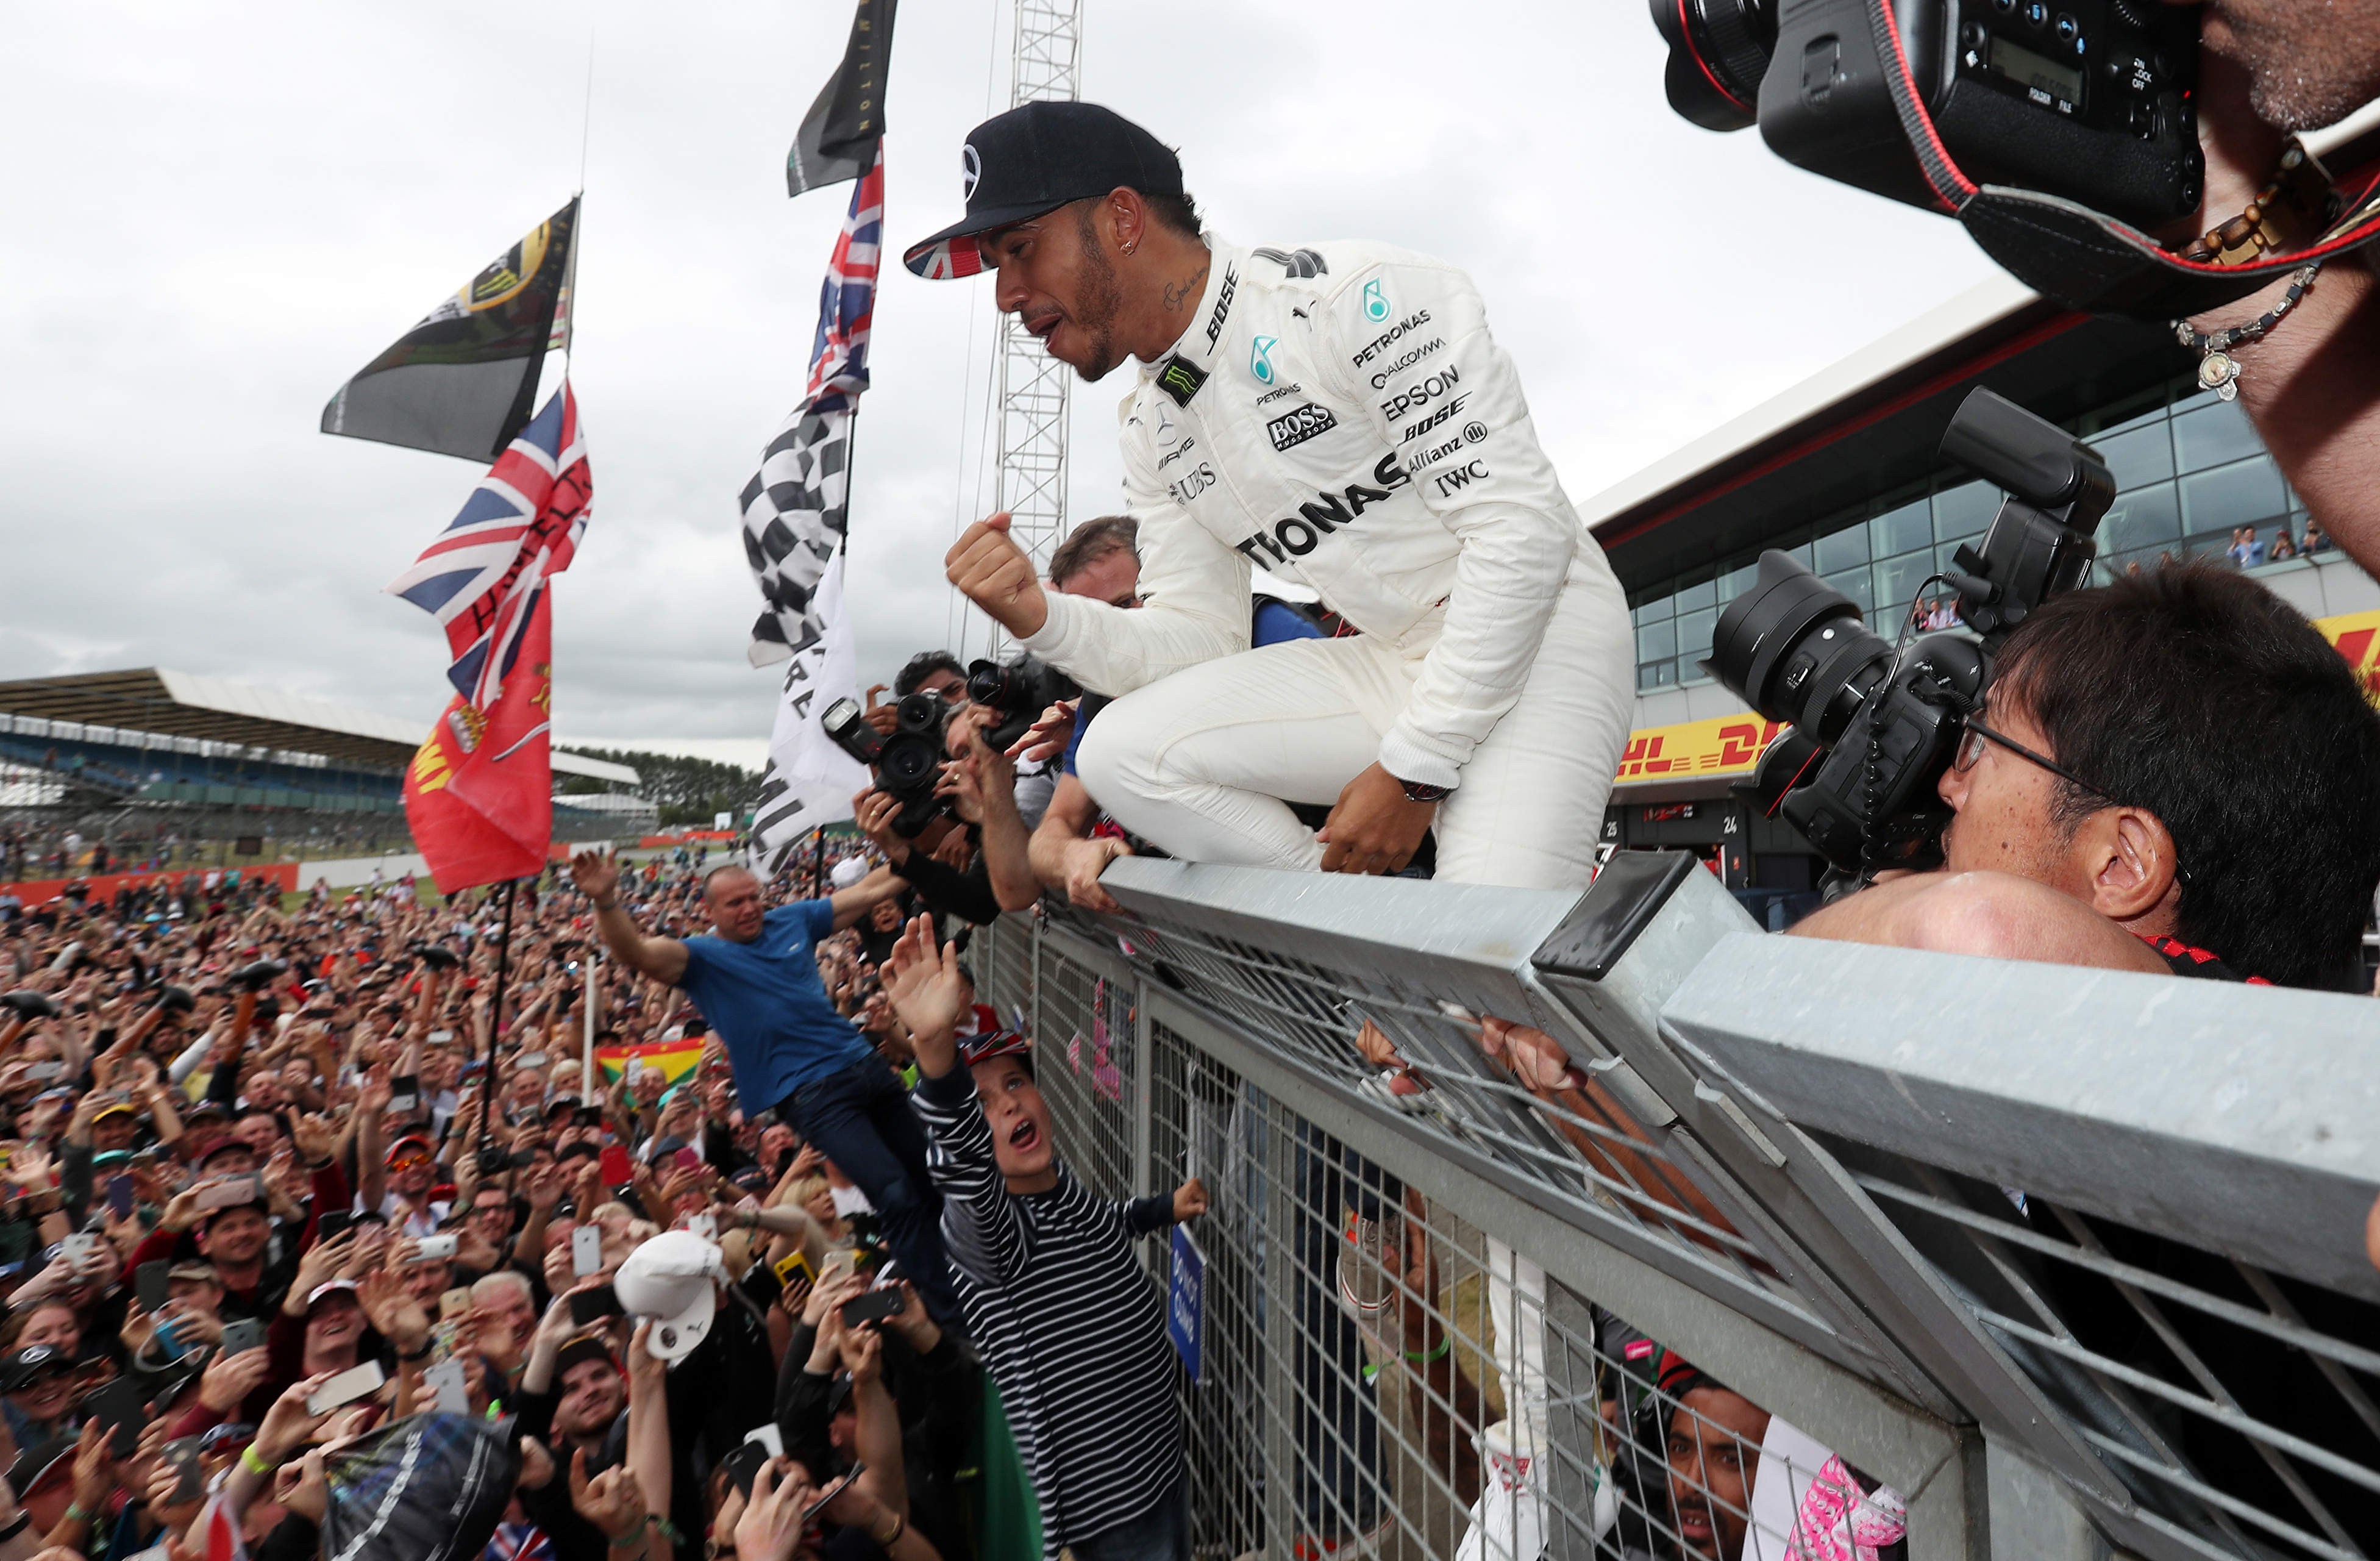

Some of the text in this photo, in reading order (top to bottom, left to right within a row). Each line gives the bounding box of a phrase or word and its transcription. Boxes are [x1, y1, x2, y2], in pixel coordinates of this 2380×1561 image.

[2028, 87, 2072, 114] FOLDER FILE
[2132, 78, 2145, 90] OFF
[1206, 259, 1239, 356] BOSE
[1352, 309, 1432, 369] PETRONAS
[1370, 337, 1447, 390] QALCOMM
[1380, 363, 1461, 422] EPSON
[1269, 403, 1330, 445] BOSS
[1277, 419, 1334, 449] HUGO BOSS
[1396, 390, 1473, 448] BOSE
[1408, 436, 1464, 473] Allianz
[1177, 461, 1217, 501] UBS
[1434, 457, 1489, 498] IWC
[1723, 816, 1737, 835] 24
